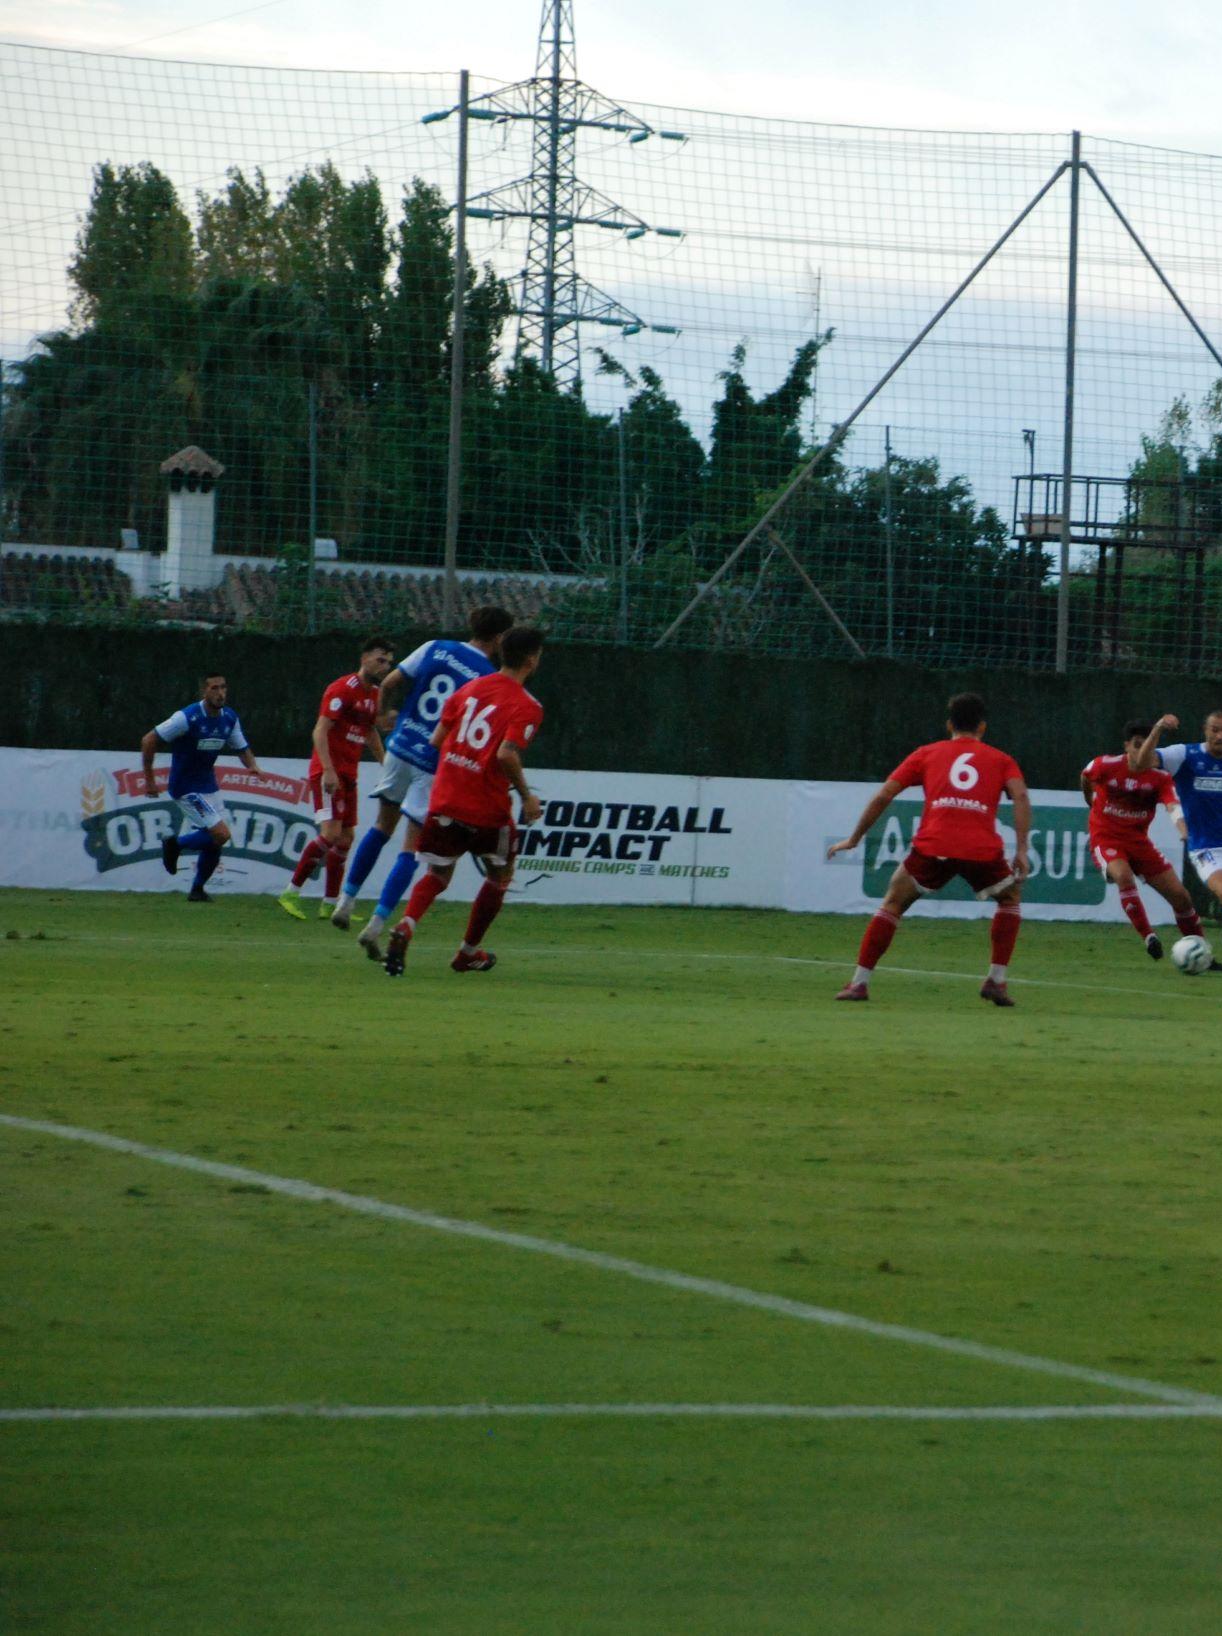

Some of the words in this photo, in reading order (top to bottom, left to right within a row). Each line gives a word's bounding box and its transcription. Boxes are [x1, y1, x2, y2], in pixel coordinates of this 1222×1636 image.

[417, 674, 456, 721] 8
[456, 696, 498, 750] 16
[950, 752, 979, 791] 6
[515, 829, 671, 861] IMPACT
[515, 857, 582, 874] RAINING
[583, 861, 636, 876] CAMPS
[659, 864, 731, 878] MATCHES
